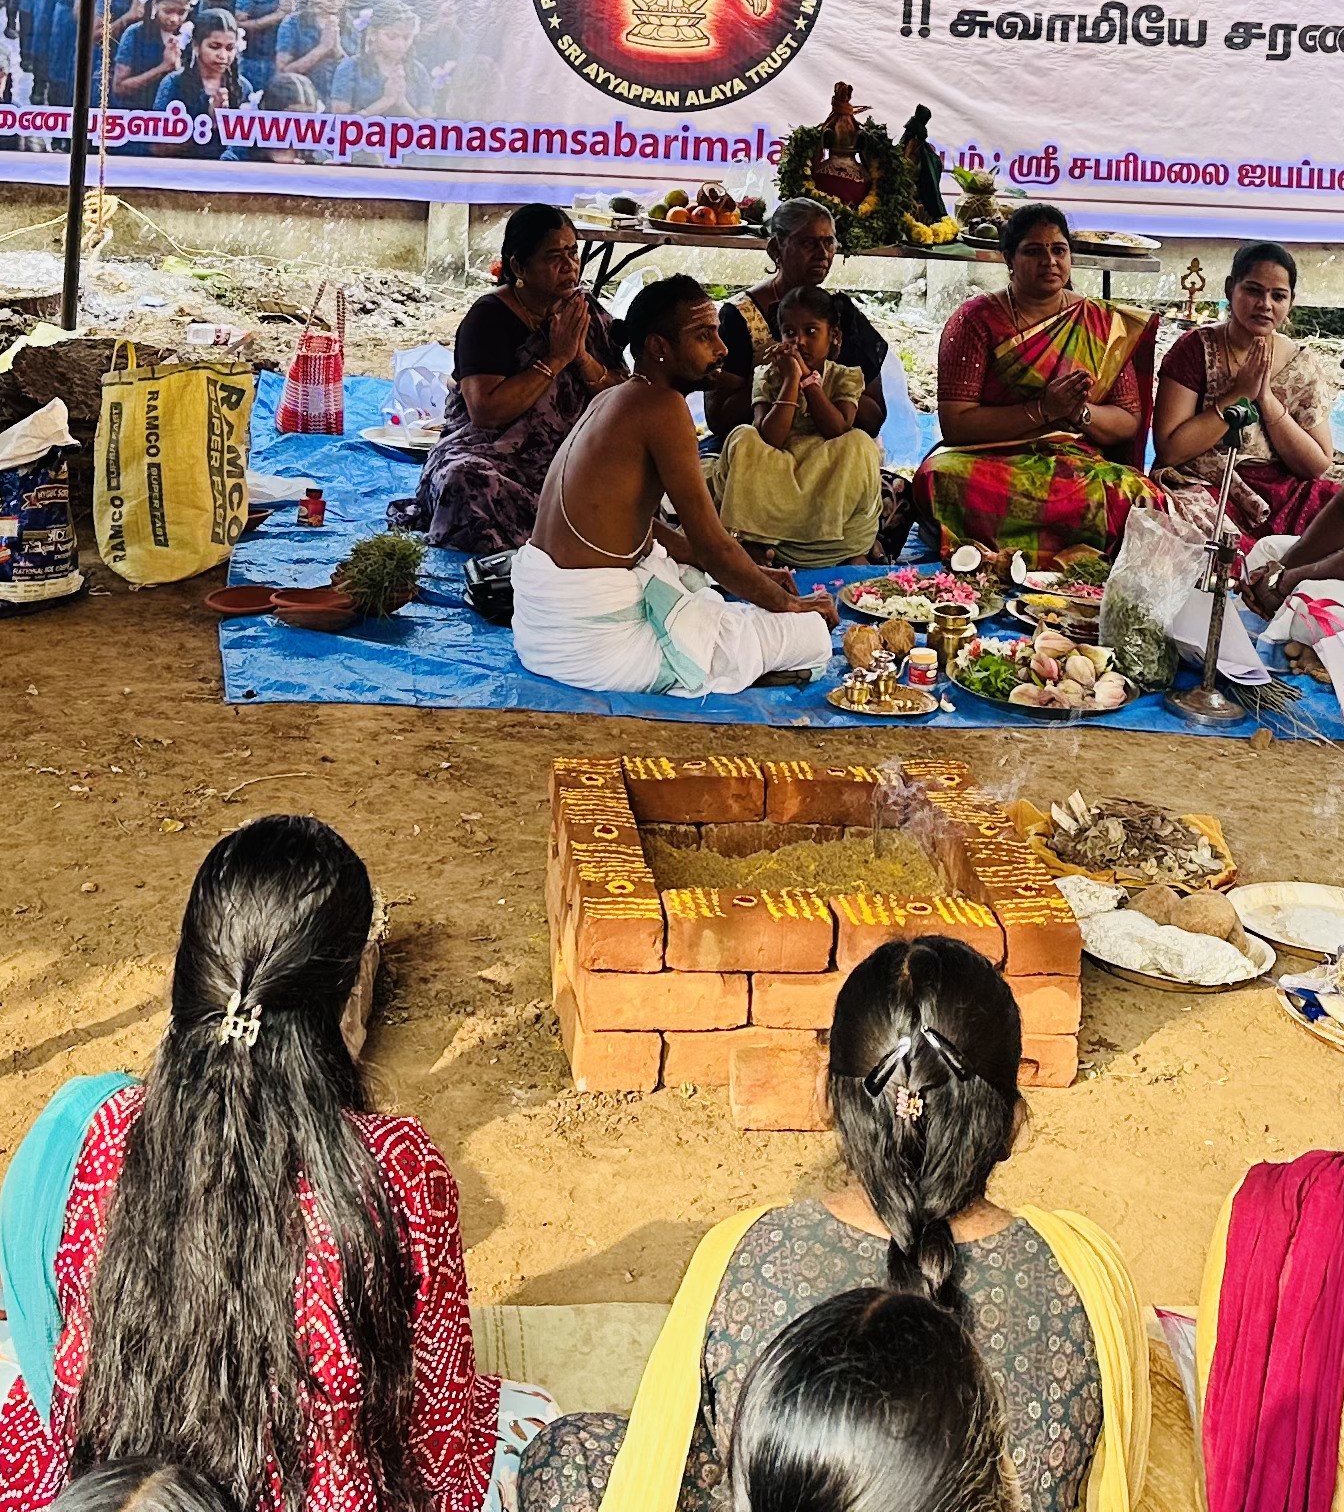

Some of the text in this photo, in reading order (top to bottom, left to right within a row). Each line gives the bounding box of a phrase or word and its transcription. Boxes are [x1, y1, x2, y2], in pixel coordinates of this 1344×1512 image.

[949, 1, 1208, 49] சுவாமியே
[557, 32, 799, 107] SRI AYYAPPAN ALAYA TRUST
[222, 114, 784, 165] www.papanasamsabarimala
[1068, 152, 1229, 186] சபரிமலை
[145, 390, 161, 458] RAMCO
[219, 383, 246, 547] RAMCO
[110, 495, 127, 563] RAMCO
